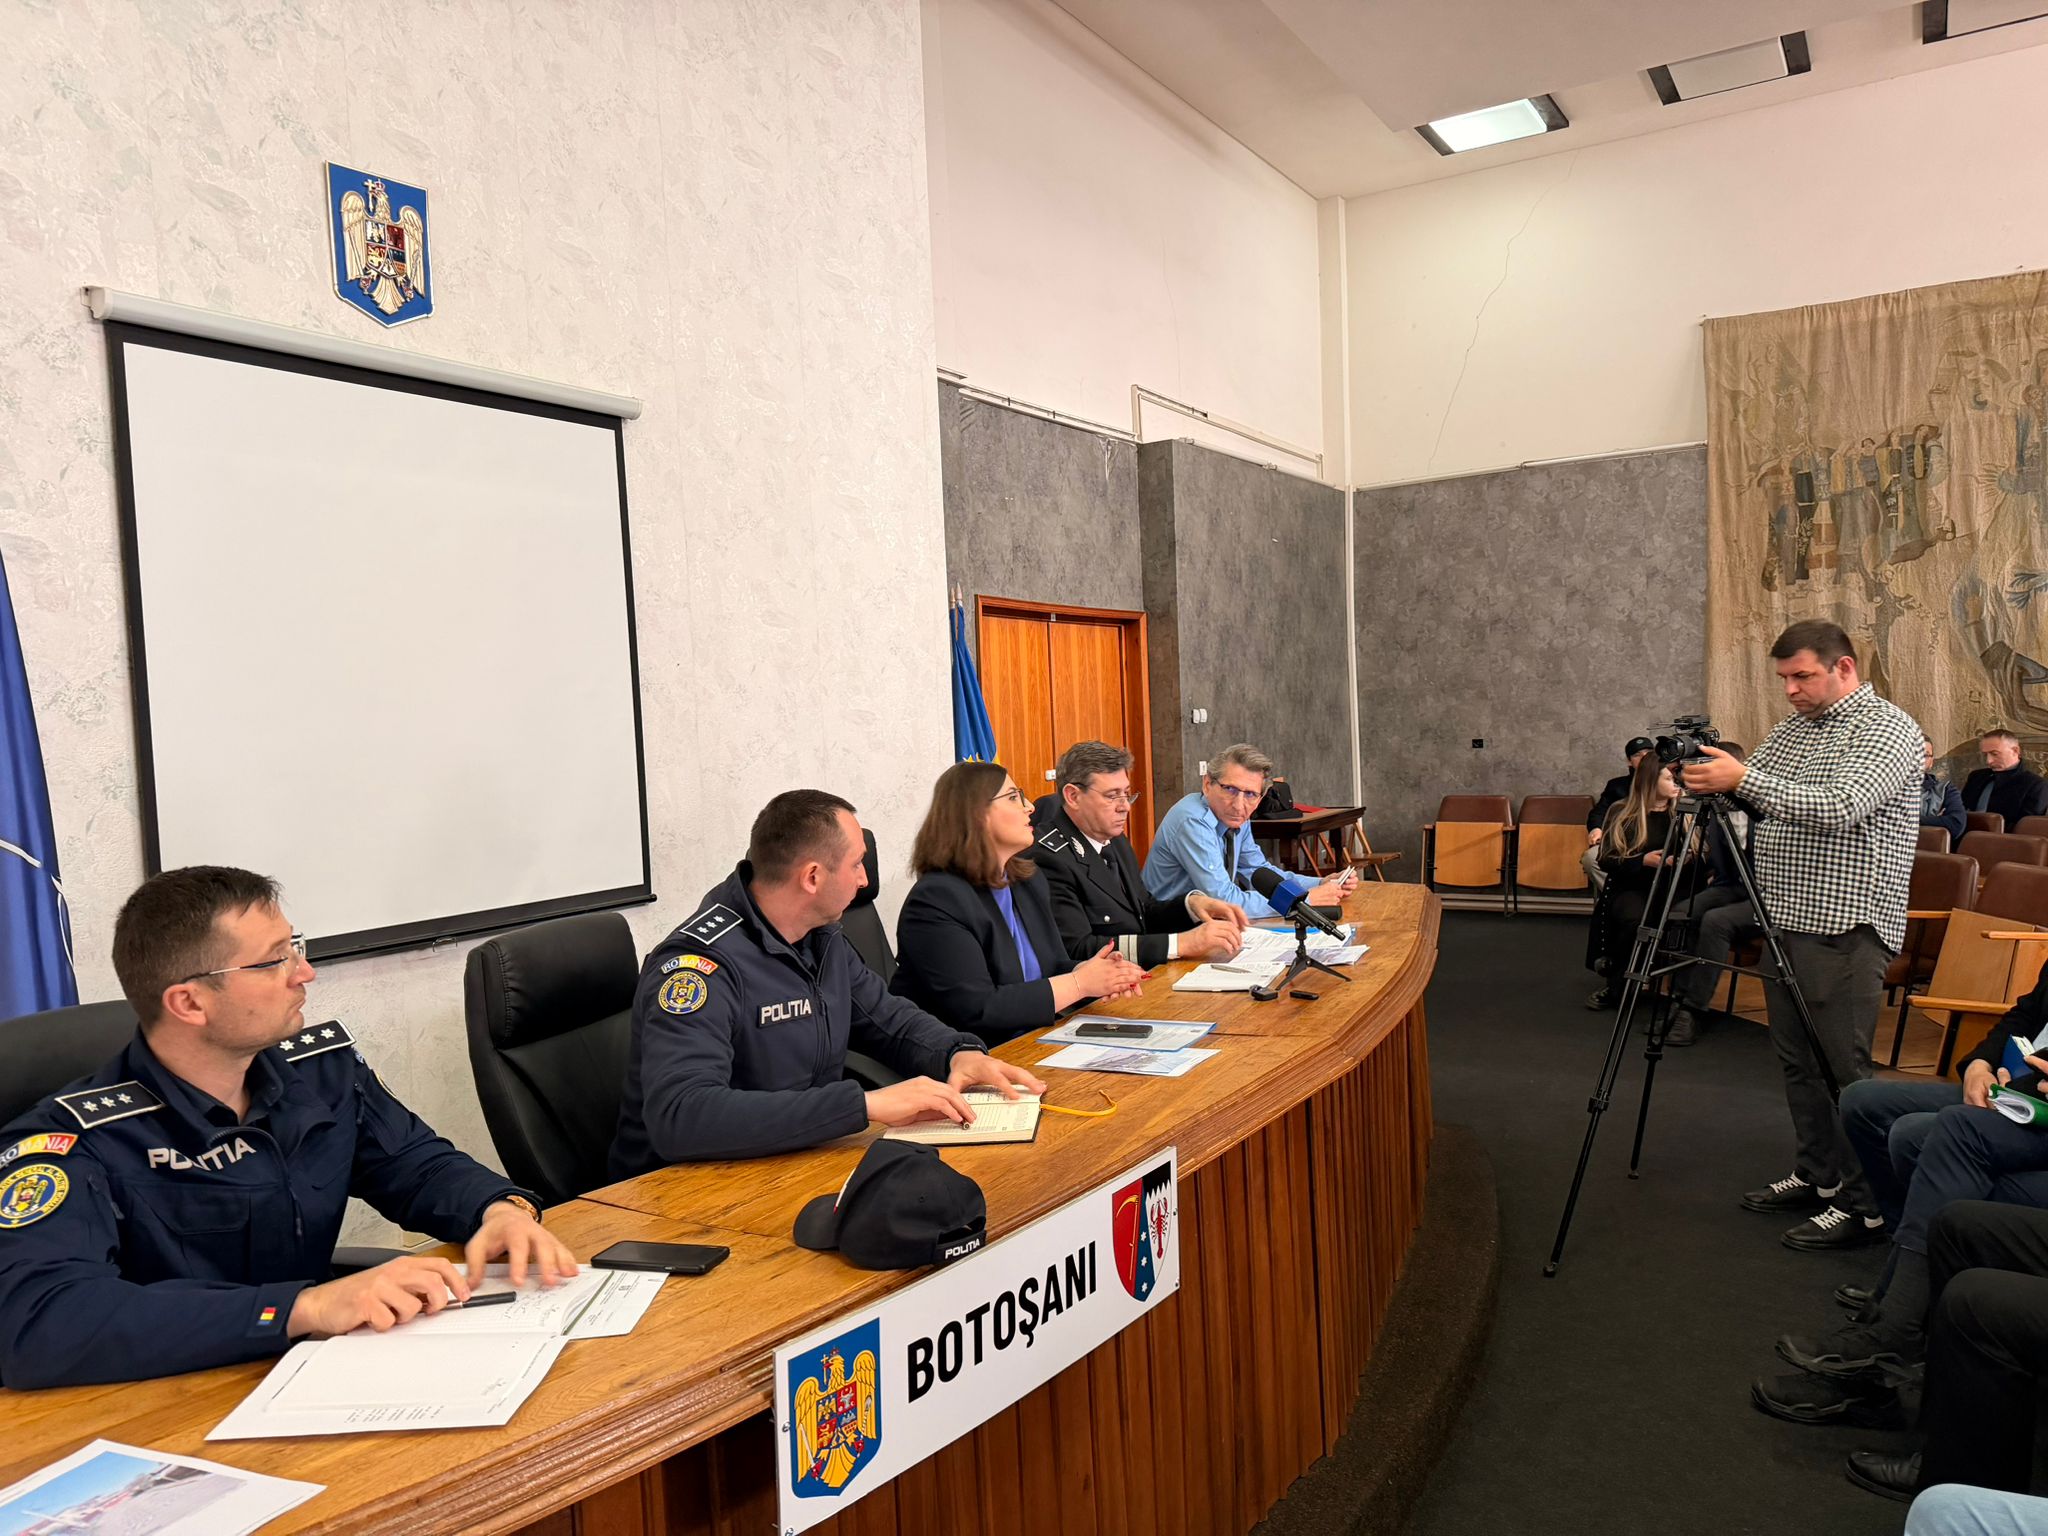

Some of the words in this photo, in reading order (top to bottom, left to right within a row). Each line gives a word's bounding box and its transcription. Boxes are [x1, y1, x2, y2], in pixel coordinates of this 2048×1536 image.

[761, 998, 812, 1024] POLITIA
[147, 1137, 257, 1171] POITIA
[945, 1238, 980, 1259] POLITIA
